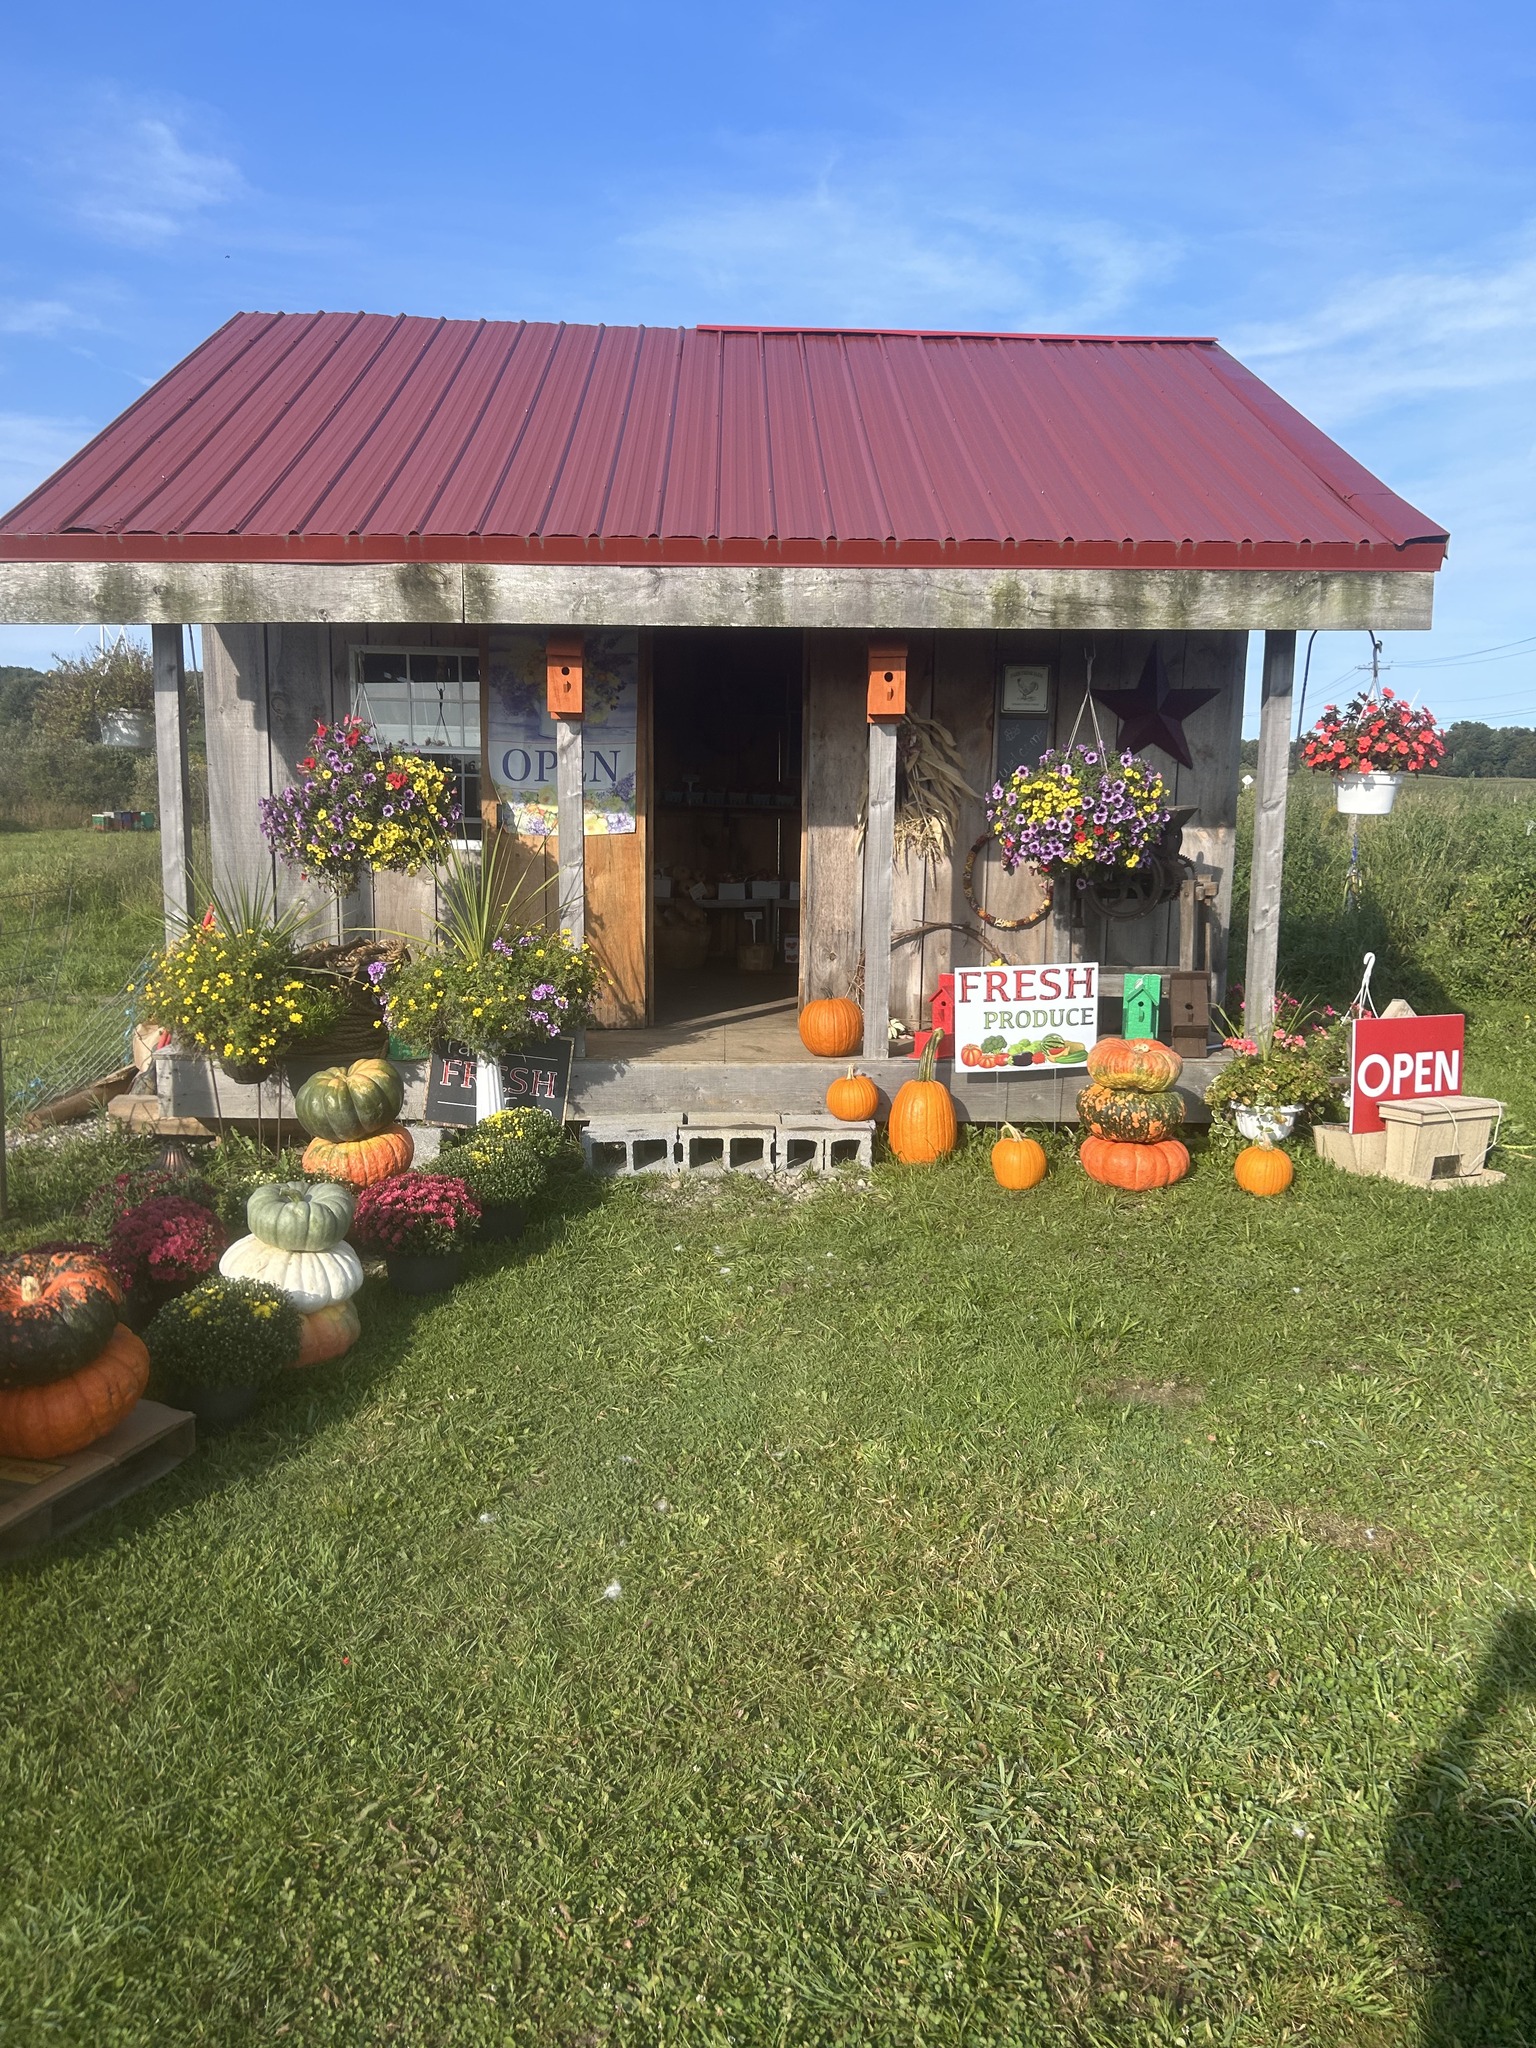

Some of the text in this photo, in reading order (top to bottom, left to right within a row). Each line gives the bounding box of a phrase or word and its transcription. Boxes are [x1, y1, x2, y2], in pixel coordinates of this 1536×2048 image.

[502, 748, 621, 783] OPN
[958, 967, 1095, 1003] FRESH
[983, 1007, 1094, 1030] PRODUCE
[1357, 1049, 1460, 1098] OPEN
